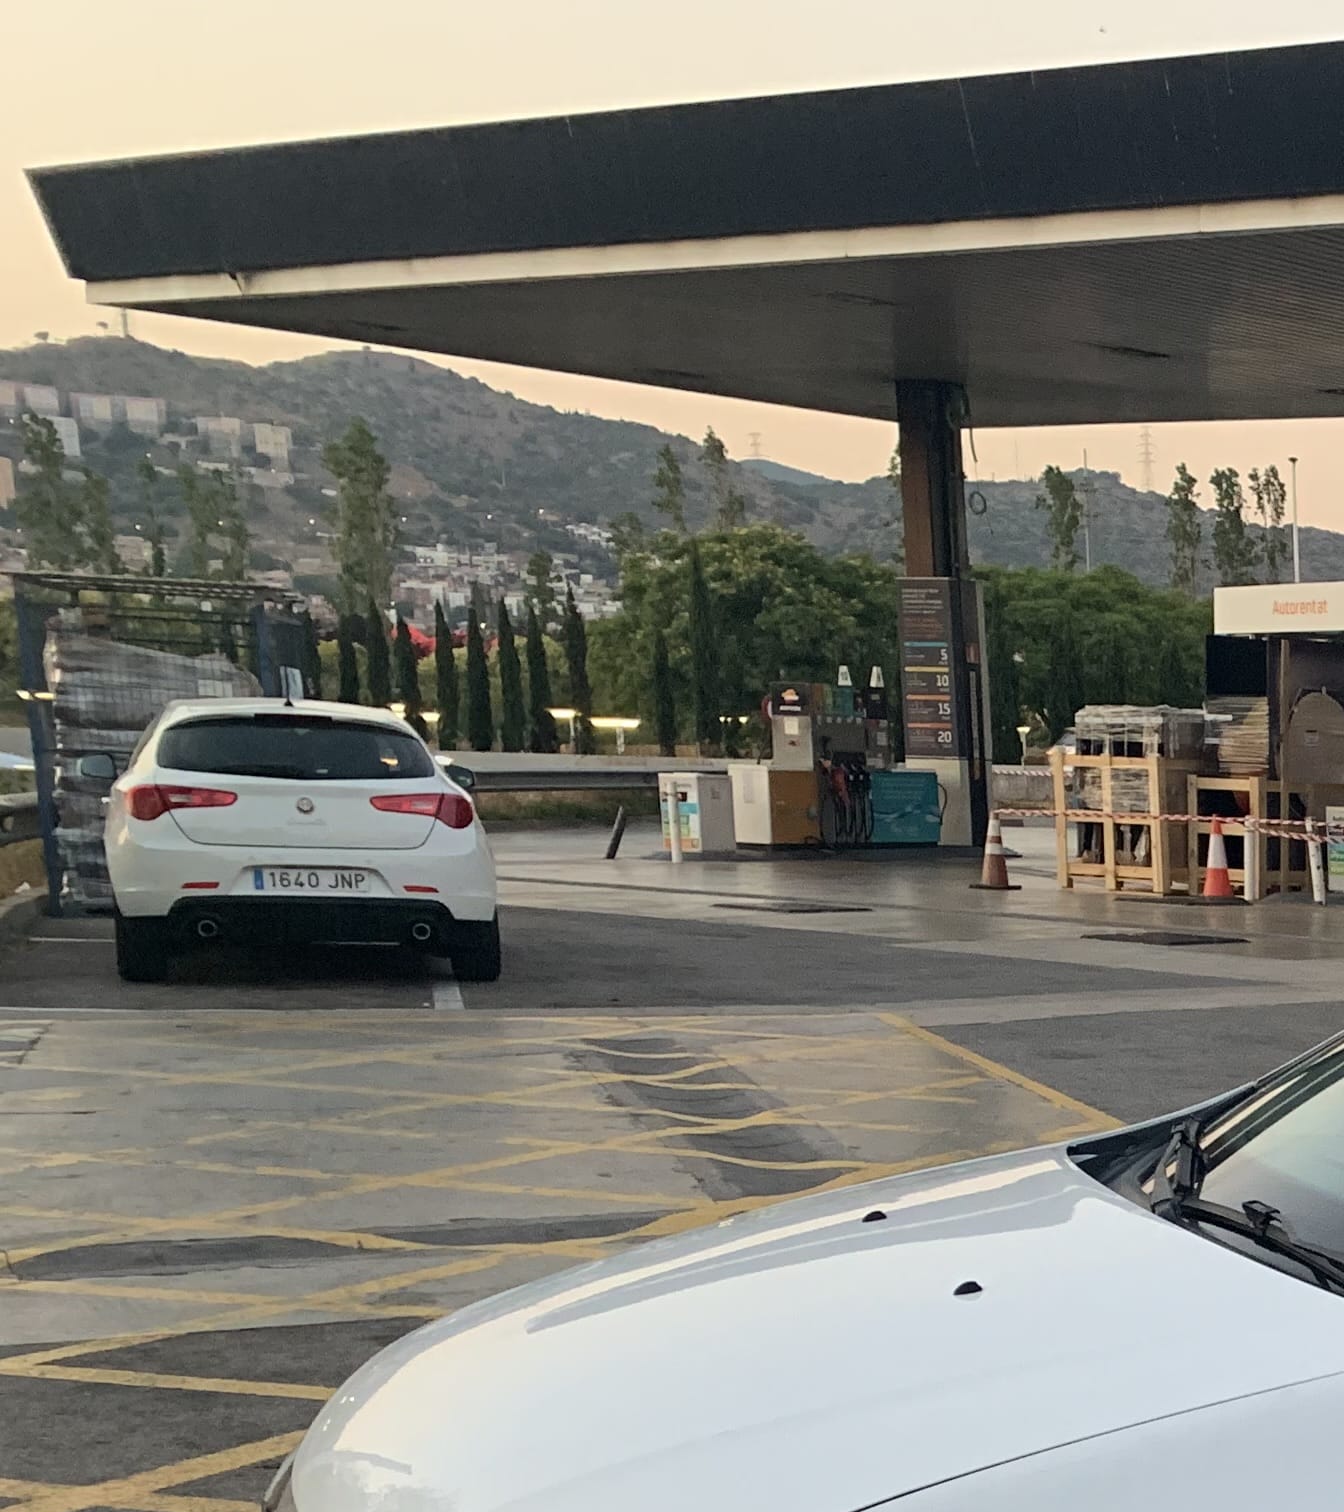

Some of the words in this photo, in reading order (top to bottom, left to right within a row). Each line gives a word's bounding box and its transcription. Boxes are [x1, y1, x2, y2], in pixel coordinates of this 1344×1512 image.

[1272, 600, 1328, 615] Autorentat
[940, 648, 948, 661] 5
[935, 674, 949, 687] 10
[938, 702, 951, 715] 15
[937, 730, 952, 743] 20
[268, 871, 320, 889] 1640
[327, 872, 366, 890] JNP
